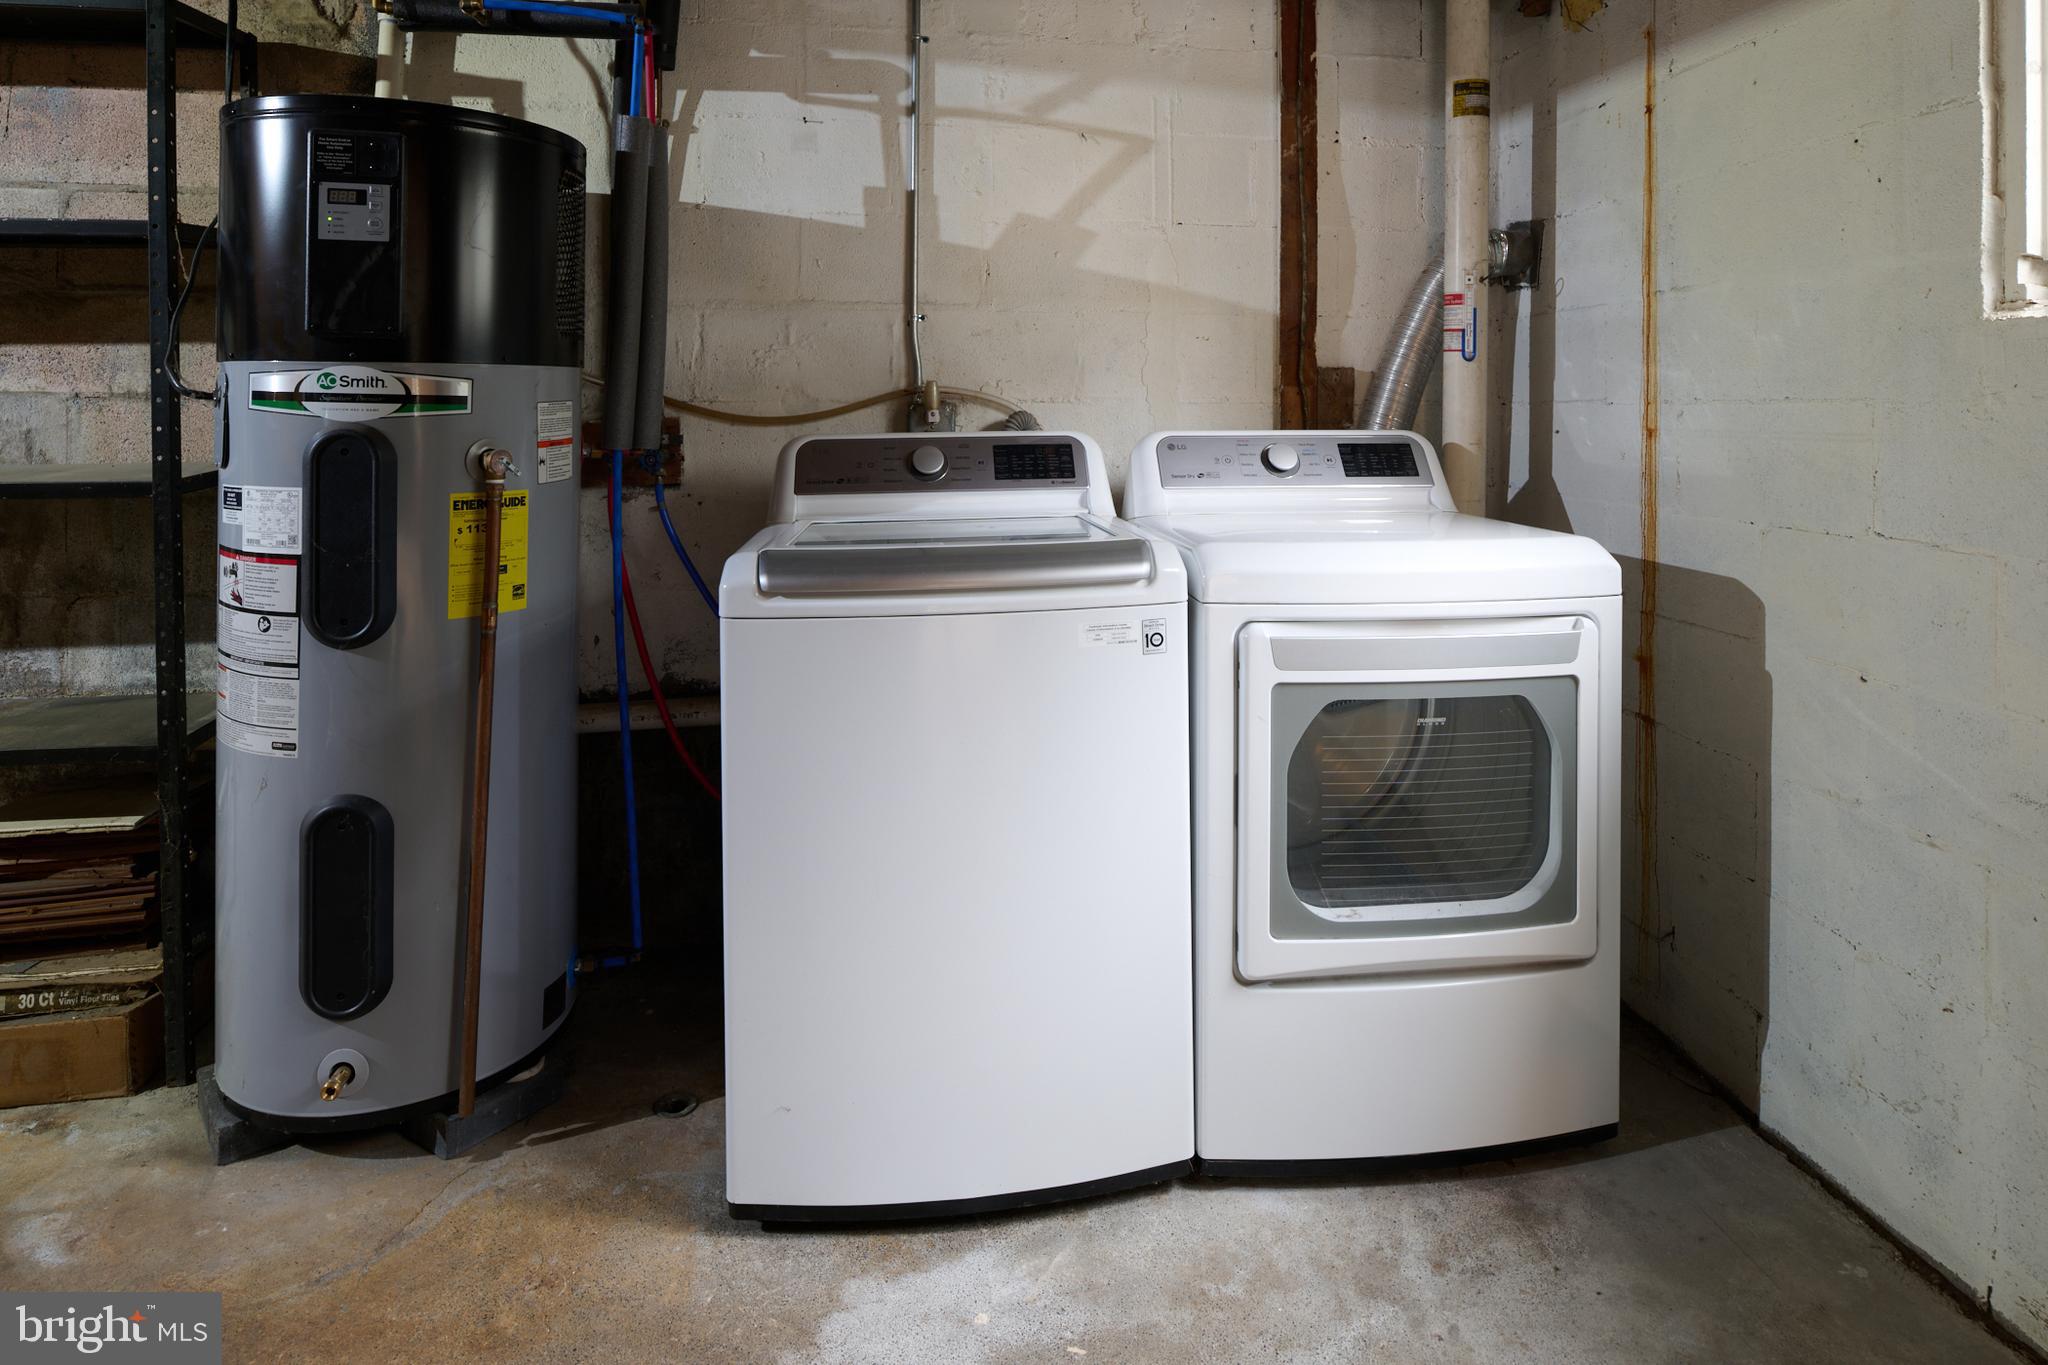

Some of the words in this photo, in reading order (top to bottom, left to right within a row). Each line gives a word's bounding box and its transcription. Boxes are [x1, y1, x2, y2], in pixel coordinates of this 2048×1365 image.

[18, 994, 34, 1009] 30
[39, 992, 54, 1006] Ct
[59, 996, 78, 1006] Vinyl
[80, 995, 99, 1003] Floor
[102, 992, 120, 1001] Tiles
